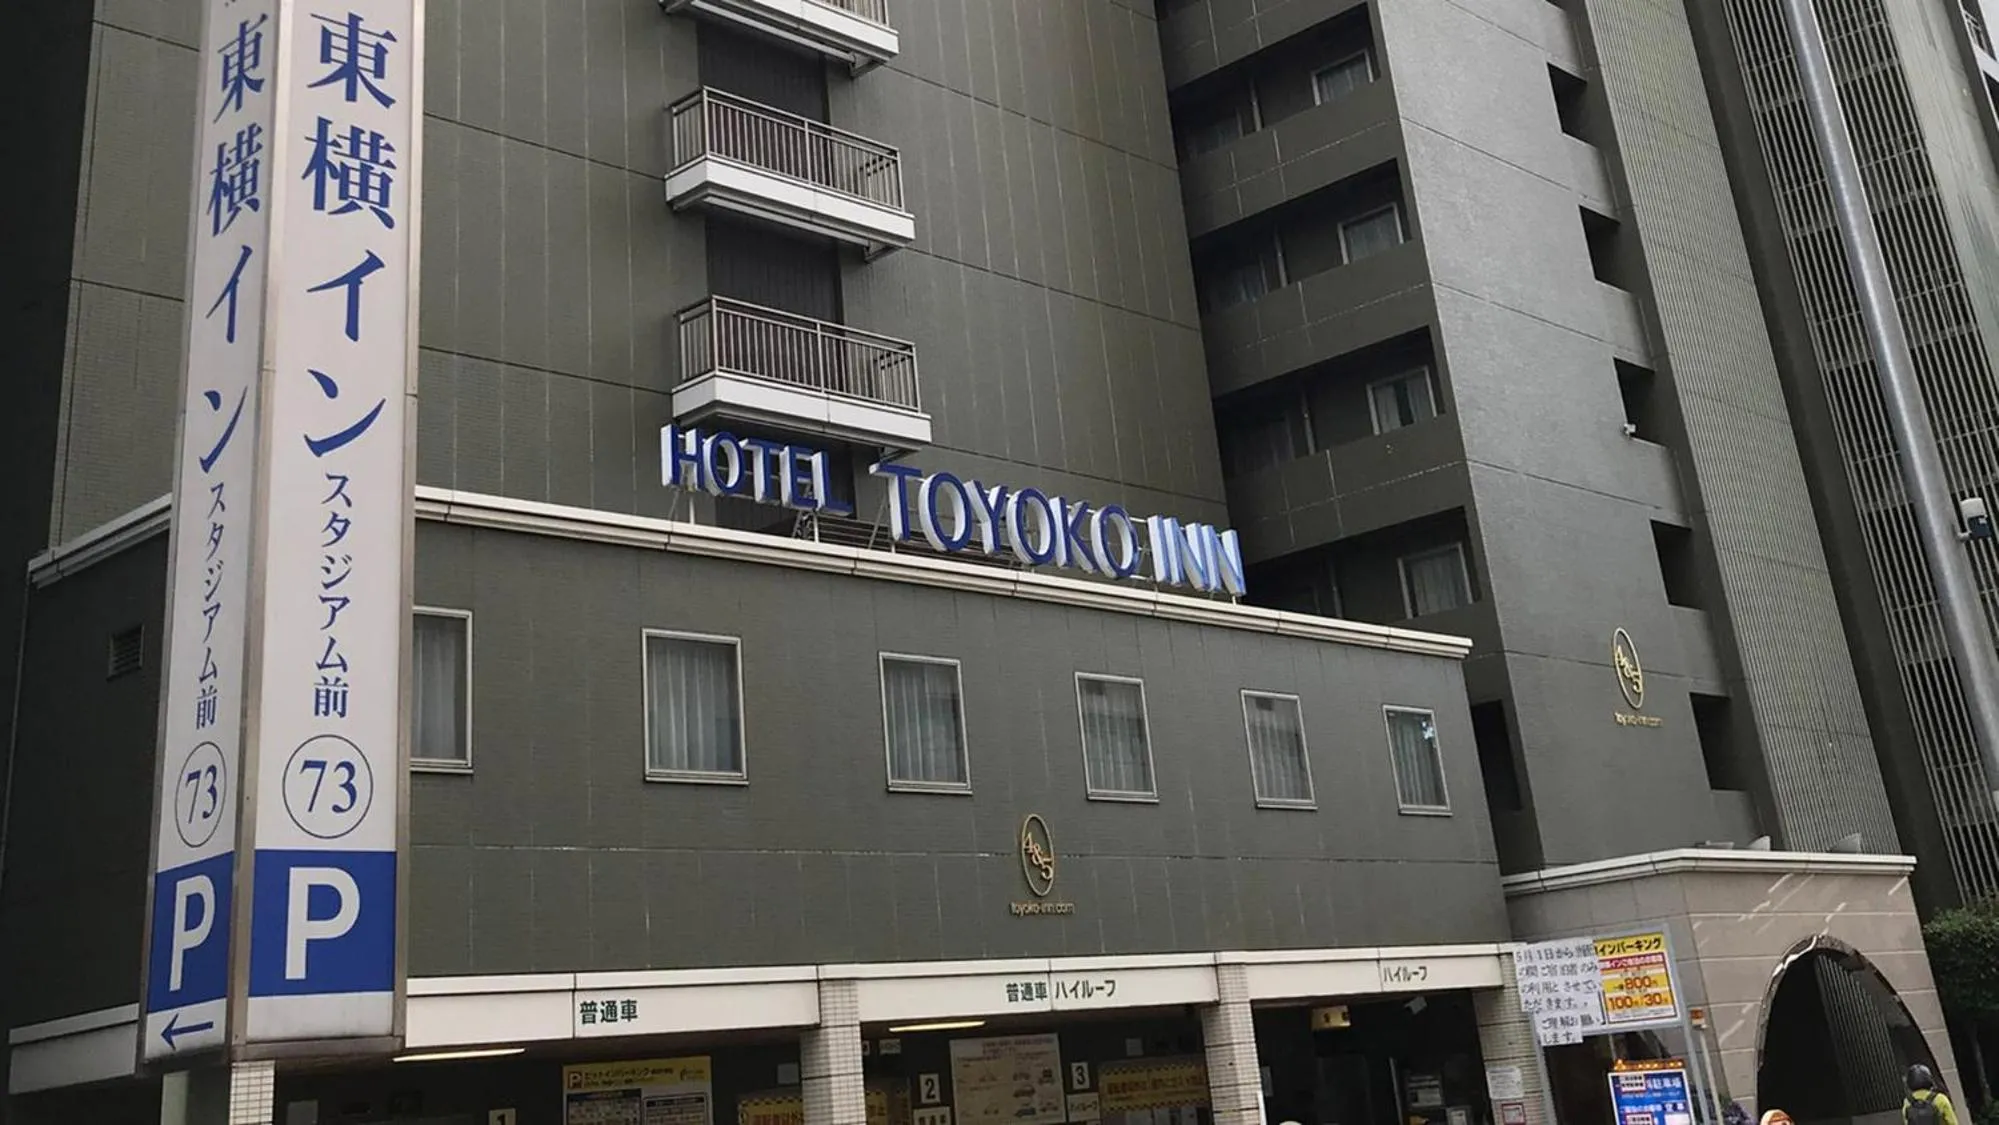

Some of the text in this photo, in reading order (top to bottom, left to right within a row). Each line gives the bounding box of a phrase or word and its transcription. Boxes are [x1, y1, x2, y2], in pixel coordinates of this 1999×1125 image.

[660, 423, 1247, 597] HOTEL TOYOKO INN
[184, 770, 218, 825] 73
[300, 760, 358, 814] 73
[169, 874, 216, 992] P
[284, 866, 361, 981] P
[1005, 979, 1117, 1003] 普通車 ハイルーフ
[1383, 966, 1427, 983] ハイルーフ
[579, 999, 638, 1025] 普通車
[925, 1078, 935, 1099] 2
[1075, 1066, 1086, 1085] 3
